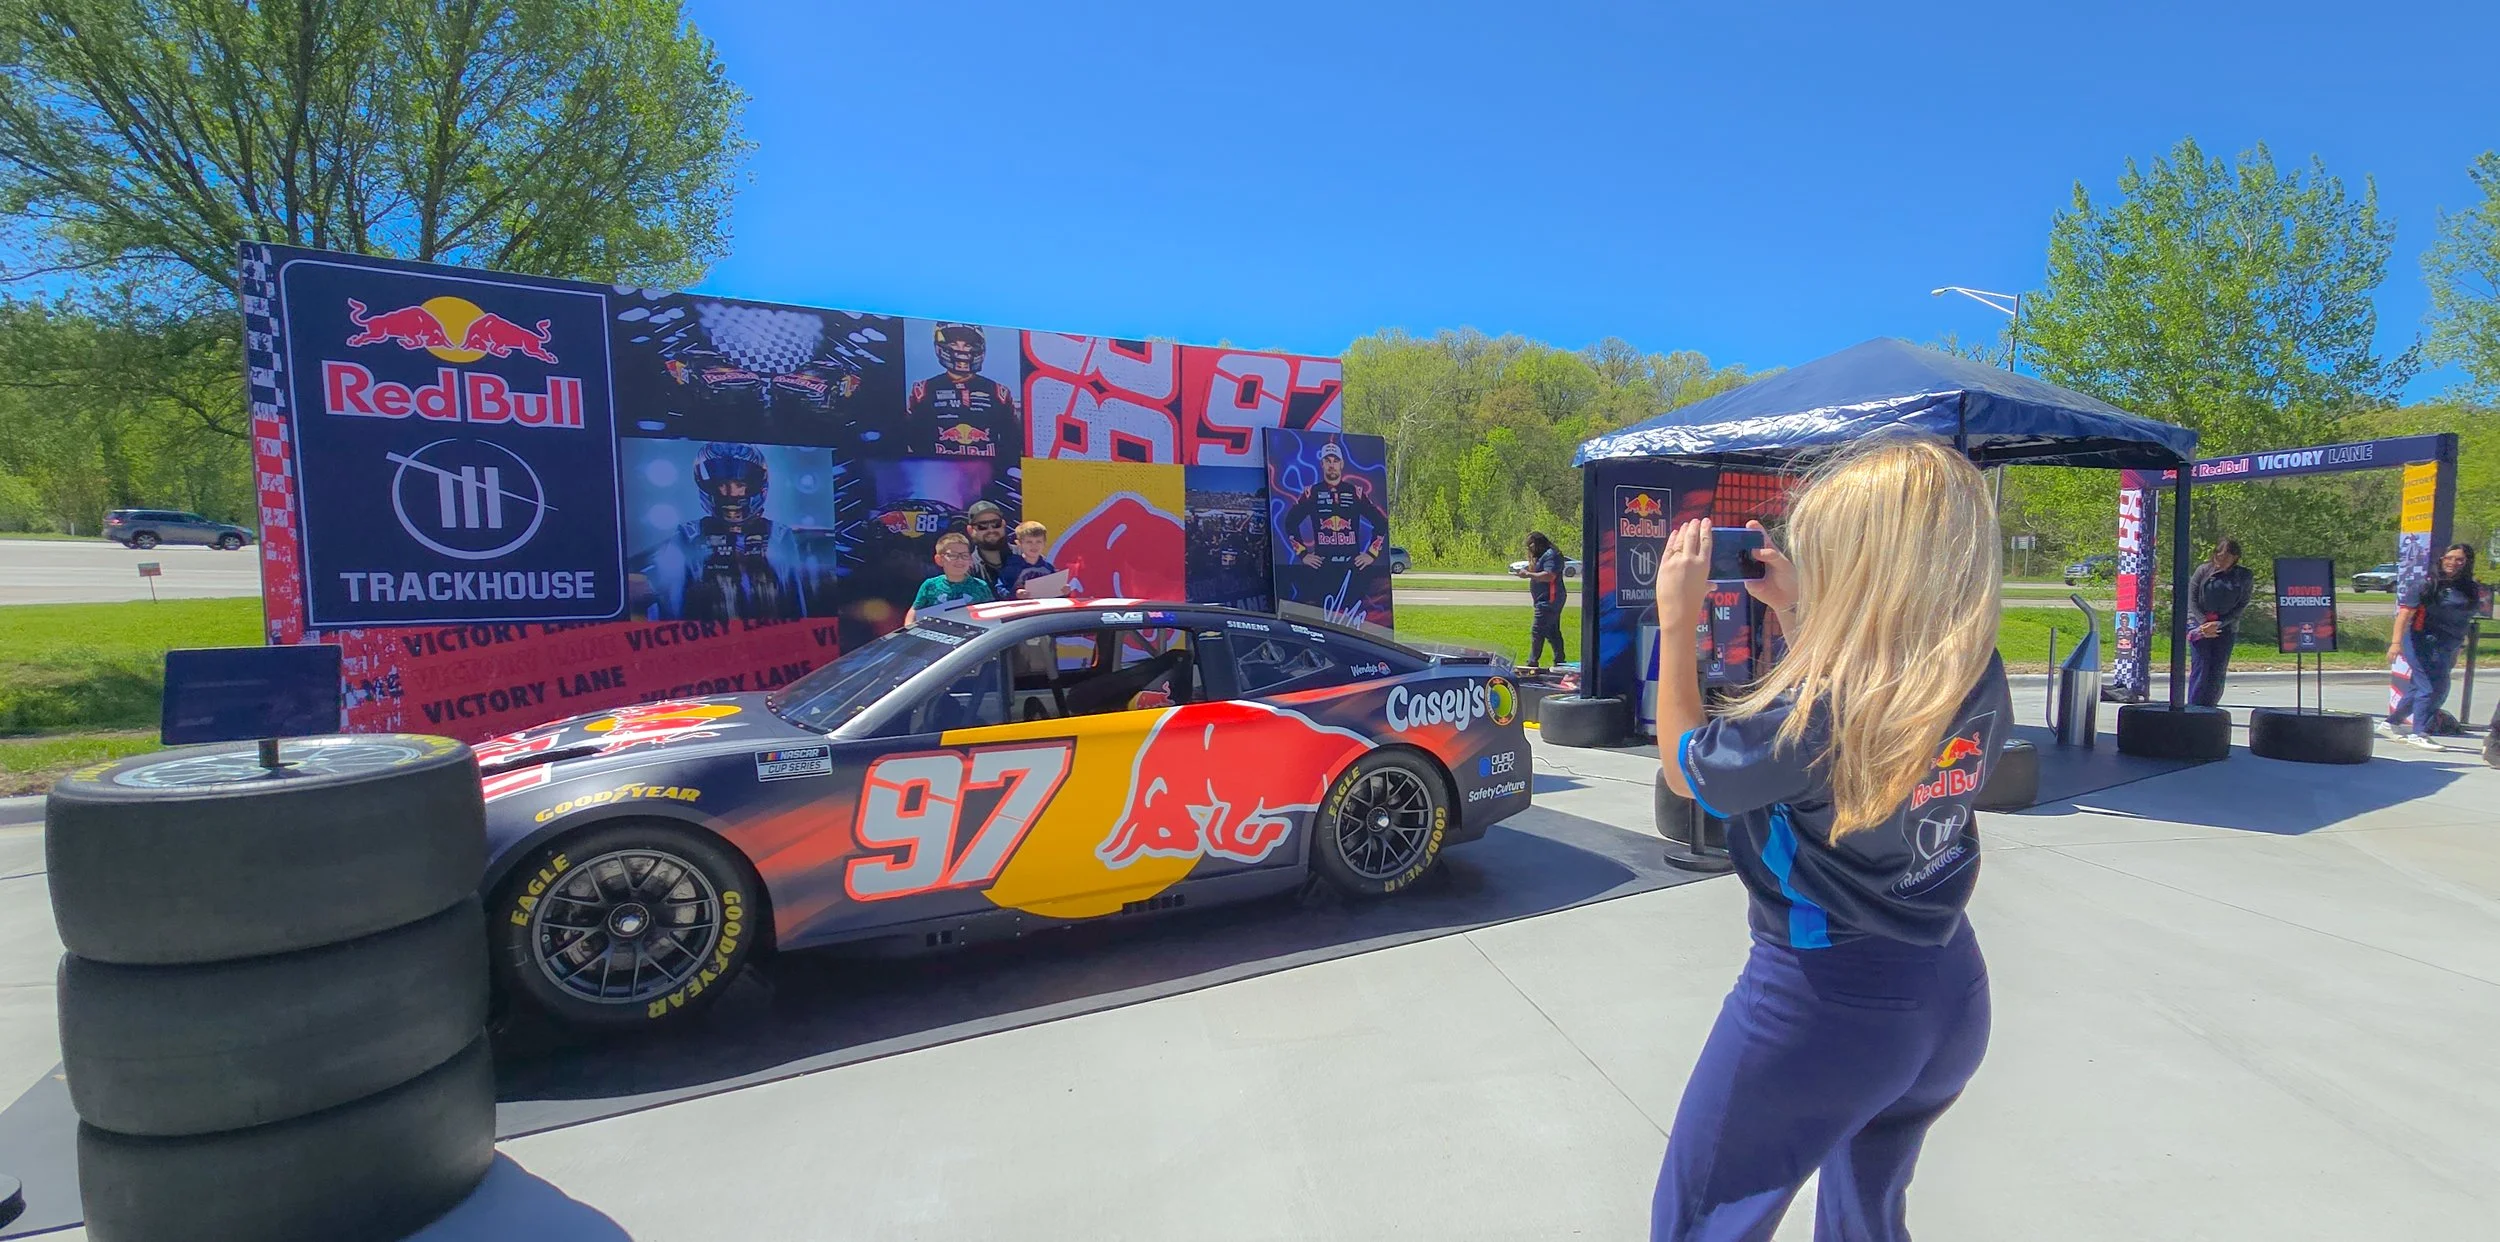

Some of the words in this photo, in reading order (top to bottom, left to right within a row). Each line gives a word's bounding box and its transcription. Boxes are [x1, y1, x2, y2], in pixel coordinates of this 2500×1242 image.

[322, 360, 461, 422] Red
[464, 372, 585, 429] Bull
[1197, 352, 1341, 466] 97
[2199, 462, 2223, 477] Red
[2224, 458, 2249, 475] Bull
[2258, 450, 2324, 471] VICTORY
[2328, 444, 2373, 464] LANE
[914, 513, 939, 533] 88
[1317, 531, 1337, 545] Red
[1337, 531, 1356, 545] Bull
[1620, 517, 1644, 538] Red
[1645, 518, 1667, 538] Bull
[339, 571, 595, 602] TRACKHOUSE
[2280, 596, 2331, 607] EXPERIENCE
[2287, 586, 2322, 596] DRIVER
[401, 623, 529, 658] VICTORY
[625, 620, 731, 652] VICTORY
[1226, 620, 1270, 632] SIEMENS
[1350, 663, 1378, 677] Wendy's
[421, 680, 546, 725] VICTORY
[558, 665, 627, 698] LANE
[1386, 678, 1486, 732] Casey's
[768, 763, 787, 774] CUP
[789, 760, 821, 772] SERIES
[780, 748, 820, 760] NASCAR
[1491, 751, 1515, 764] QUAD
[1491, 763, 1515, 775] LOCK
[535, 782, 701, 823] GOODYEAR
[1328, 765, 1361, 818] EAGLE
[1468, 780, 1526, 802] SafetyCulture
[1909, 769, 1948, 812] Red
[844, 740, 1075, 902] 97
[1384, 807, 1447, 893] GOODYEAR
[1899, 842, 1968, 890] TRACKHOUSE
[511, 853, 571, 927] EAGLE
[648, 890, 744, 1019] GOODYEAR
